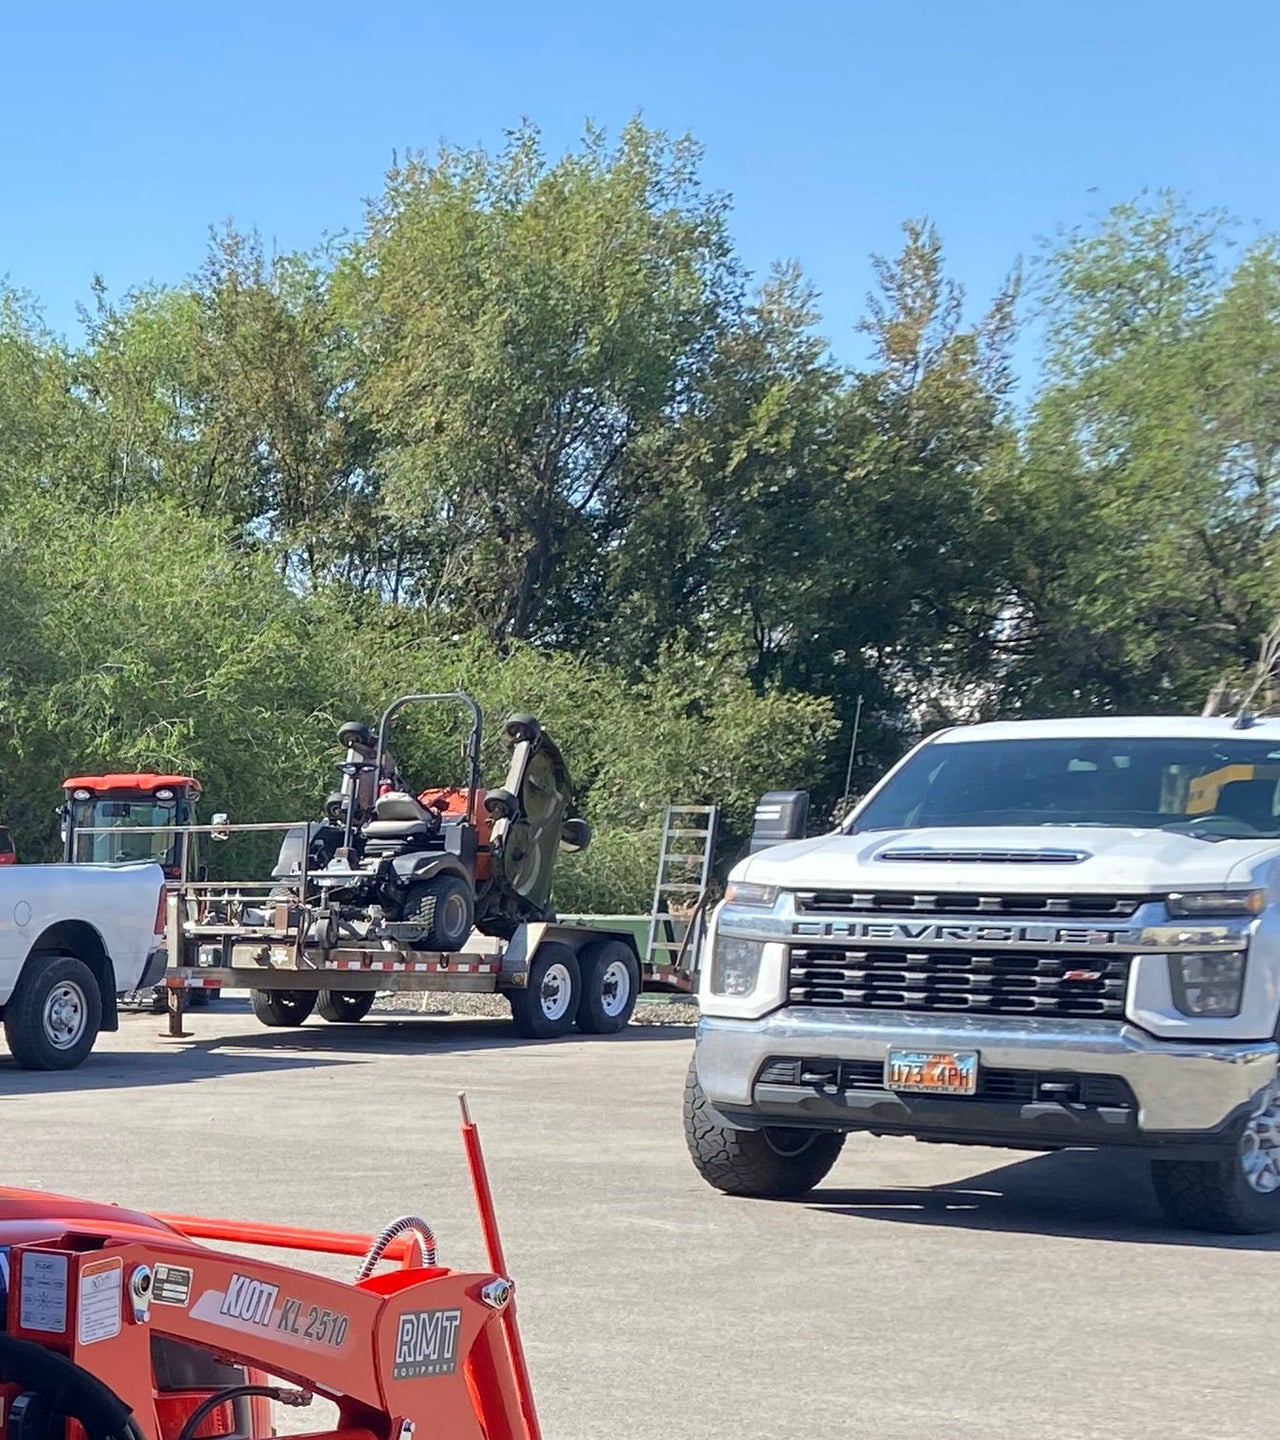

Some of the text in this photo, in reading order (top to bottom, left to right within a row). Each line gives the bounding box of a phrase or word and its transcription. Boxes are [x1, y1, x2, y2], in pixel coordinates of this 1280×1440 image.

[791, 922, 1132, 945] CHEVROLET
[220, 1273, 279, 1327] KIOTI
[278, 1296, 301, 1333] KL
[302, 1305, 350, 1347] 2510
[395, 1309, 461, 1363] RMT
[393, 1362, 456, 1377] EQUIPMENT
